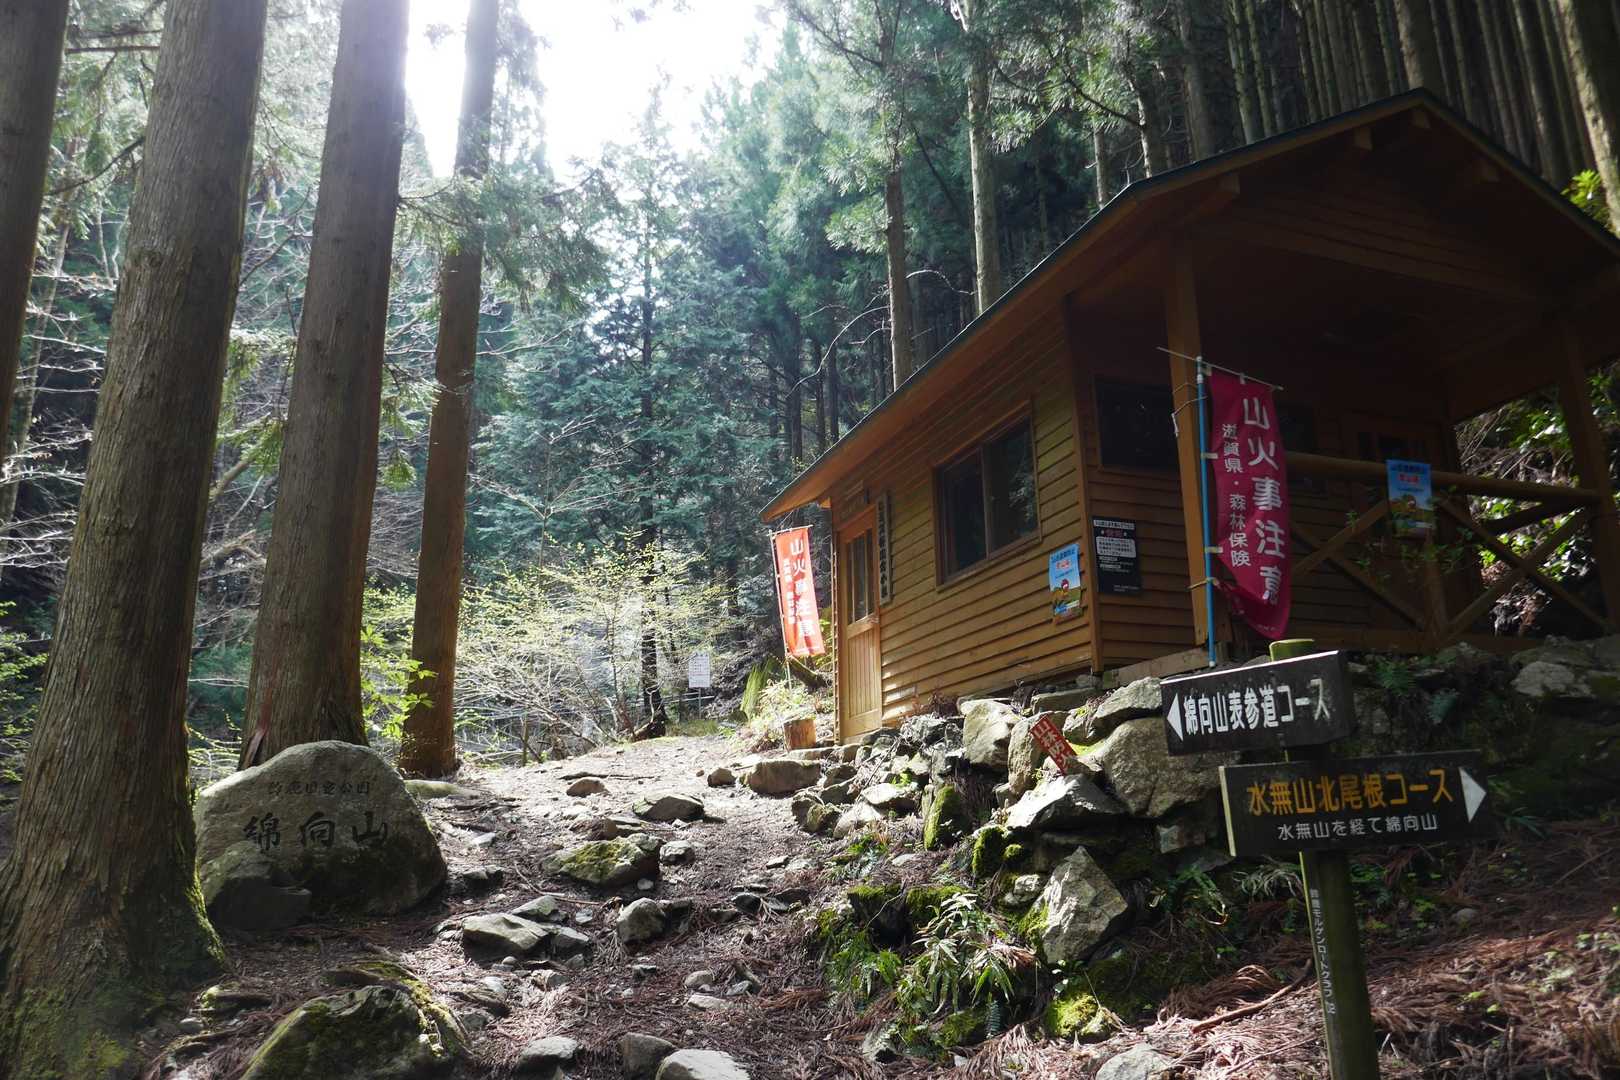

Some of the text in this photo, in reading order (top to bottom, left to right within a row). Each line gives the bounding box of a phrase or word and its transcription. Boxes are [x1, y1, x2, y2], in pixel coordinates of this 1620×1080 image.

[1243, 397, 1286, 605] 山火事注意
[1183, 678, 1330, 736] 綿向山表参道コース
[1246, 768, 1454, 816] 水無山北尾根コース
[243, 811, 388, 851] 綿向山
[1277, 813, 1438, 841] 水無山を経て綿向山
